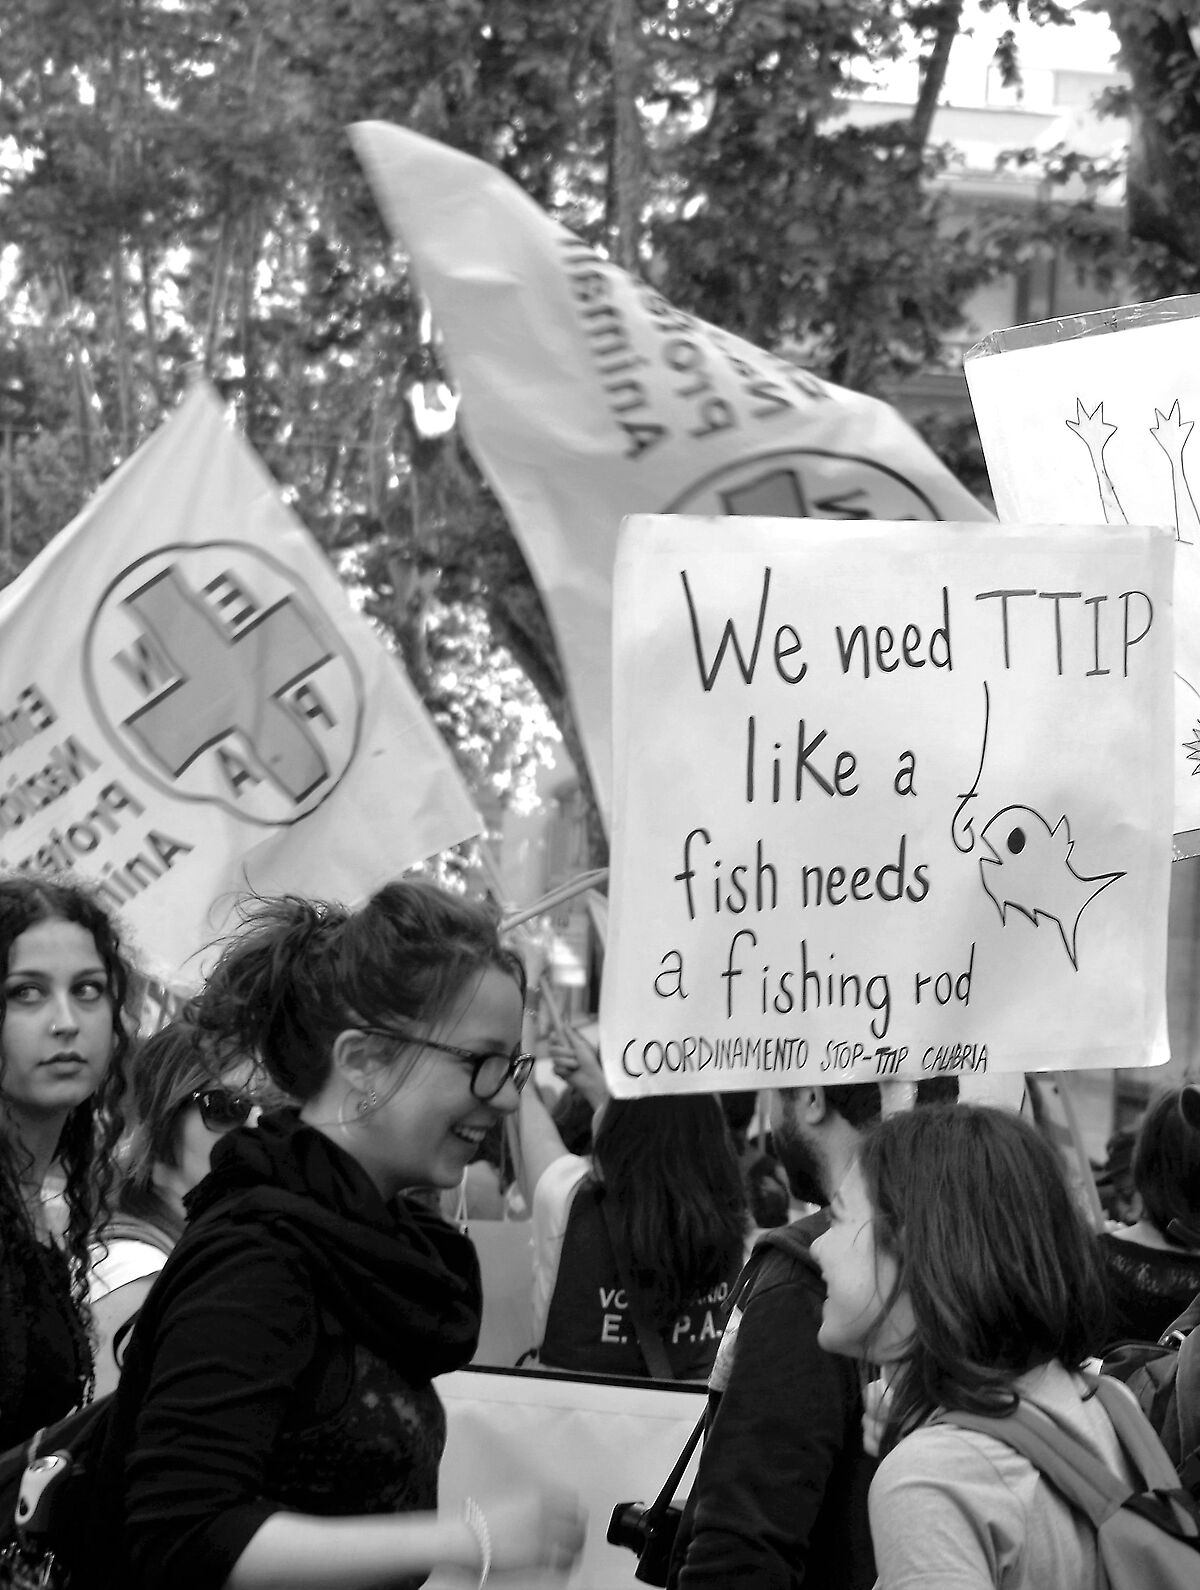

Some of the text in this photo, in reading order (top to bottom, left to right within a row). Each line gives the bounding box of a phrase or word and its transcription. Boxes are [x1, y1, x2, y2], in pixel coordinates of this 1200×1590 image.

[680, 566, 1155, 692] We need TTIP
[894, 749, 917, 797] a
[674, 828, 930, 920] fish needs
[654, 929, 976, 1040] a fishing rod
[622, 1037, 809, 1079] COORDINAMENTO
[922, 1043, 988, 1075] CALABRIA
